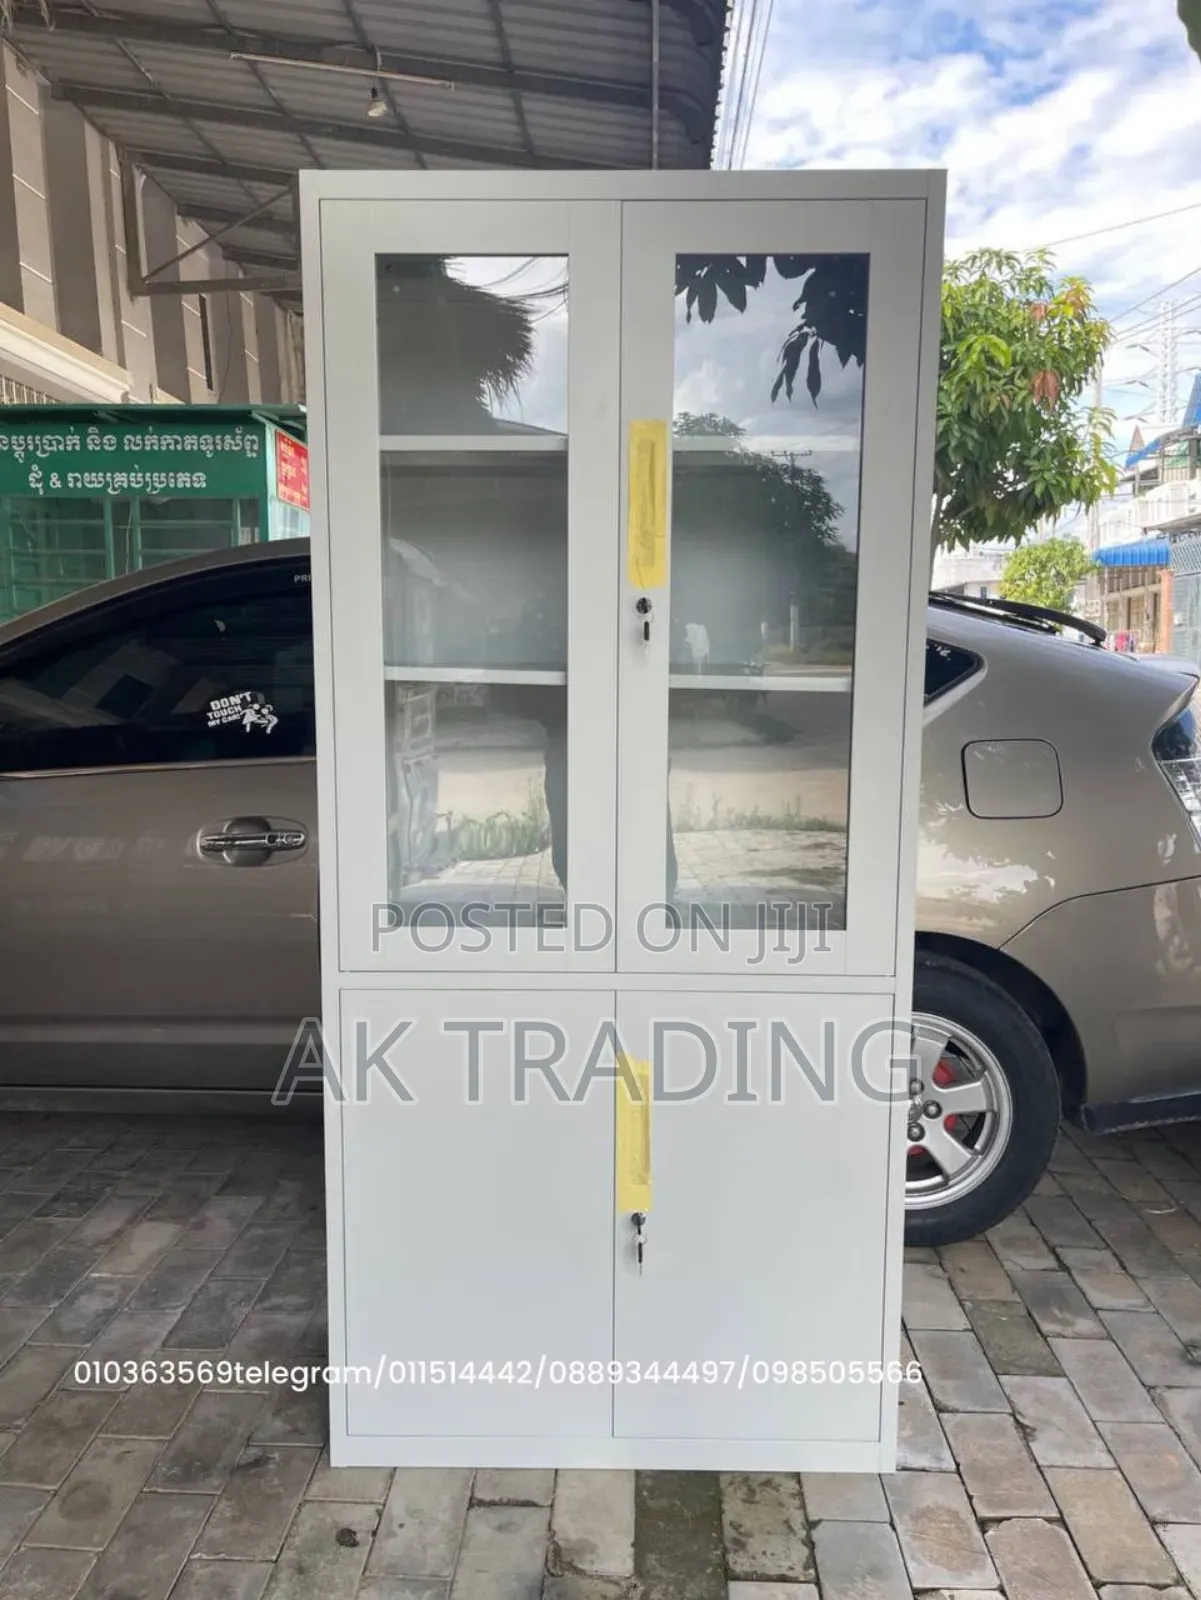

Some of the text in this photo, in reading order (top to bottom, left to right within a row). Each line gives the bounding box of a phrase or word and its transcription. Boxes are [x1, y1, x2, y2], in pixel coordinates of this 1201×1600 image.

[49, 472, 61, 488] &
[210, 691, 251, 711] DON'T
[206, 705, 242, 720] TOUCH
[207, 719, 220, 728] MY
